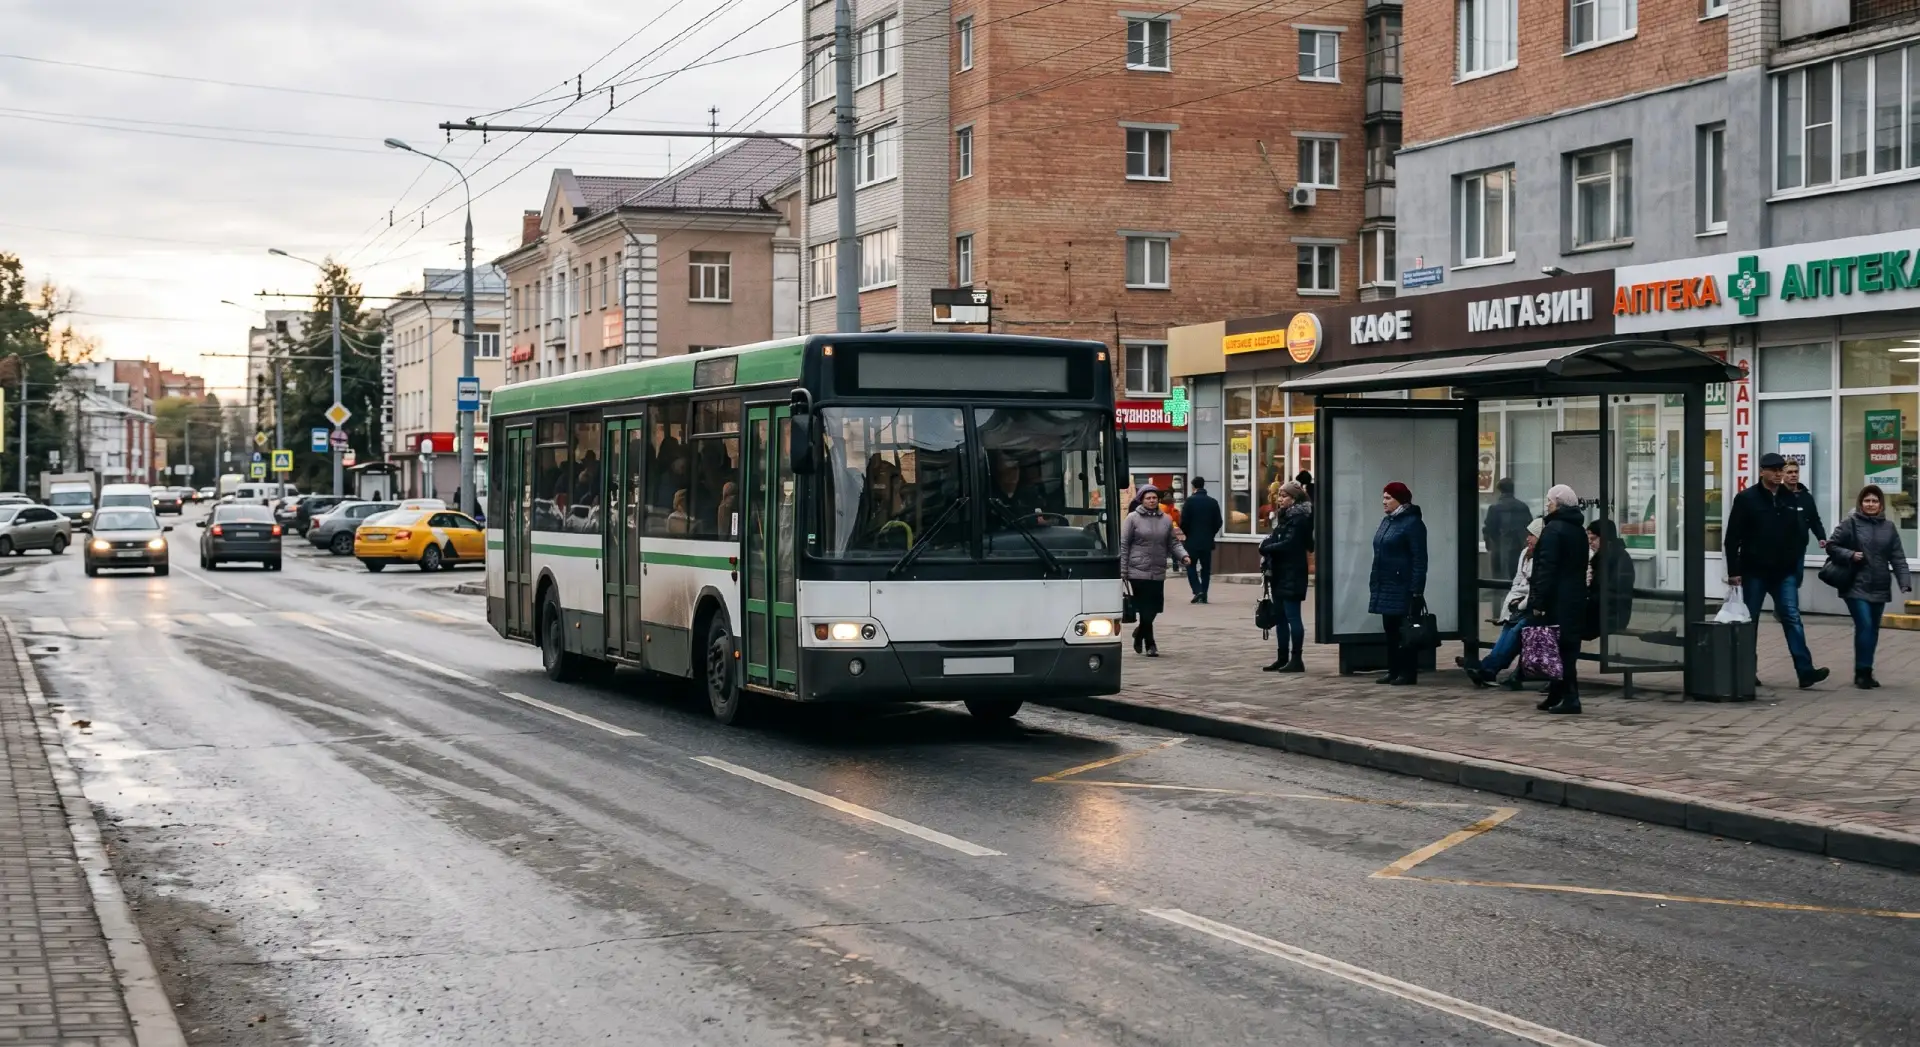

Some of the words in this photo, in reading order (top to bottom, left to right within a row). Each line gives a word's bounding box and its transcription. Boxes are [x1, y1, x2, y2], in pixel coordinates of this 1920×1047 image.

[1350, 310, 1412, 345] КАФЕ
[1467, 287, 1593, 333] МАГАЗИН
[1613, 275, 1721, 316] АПТЕКА
